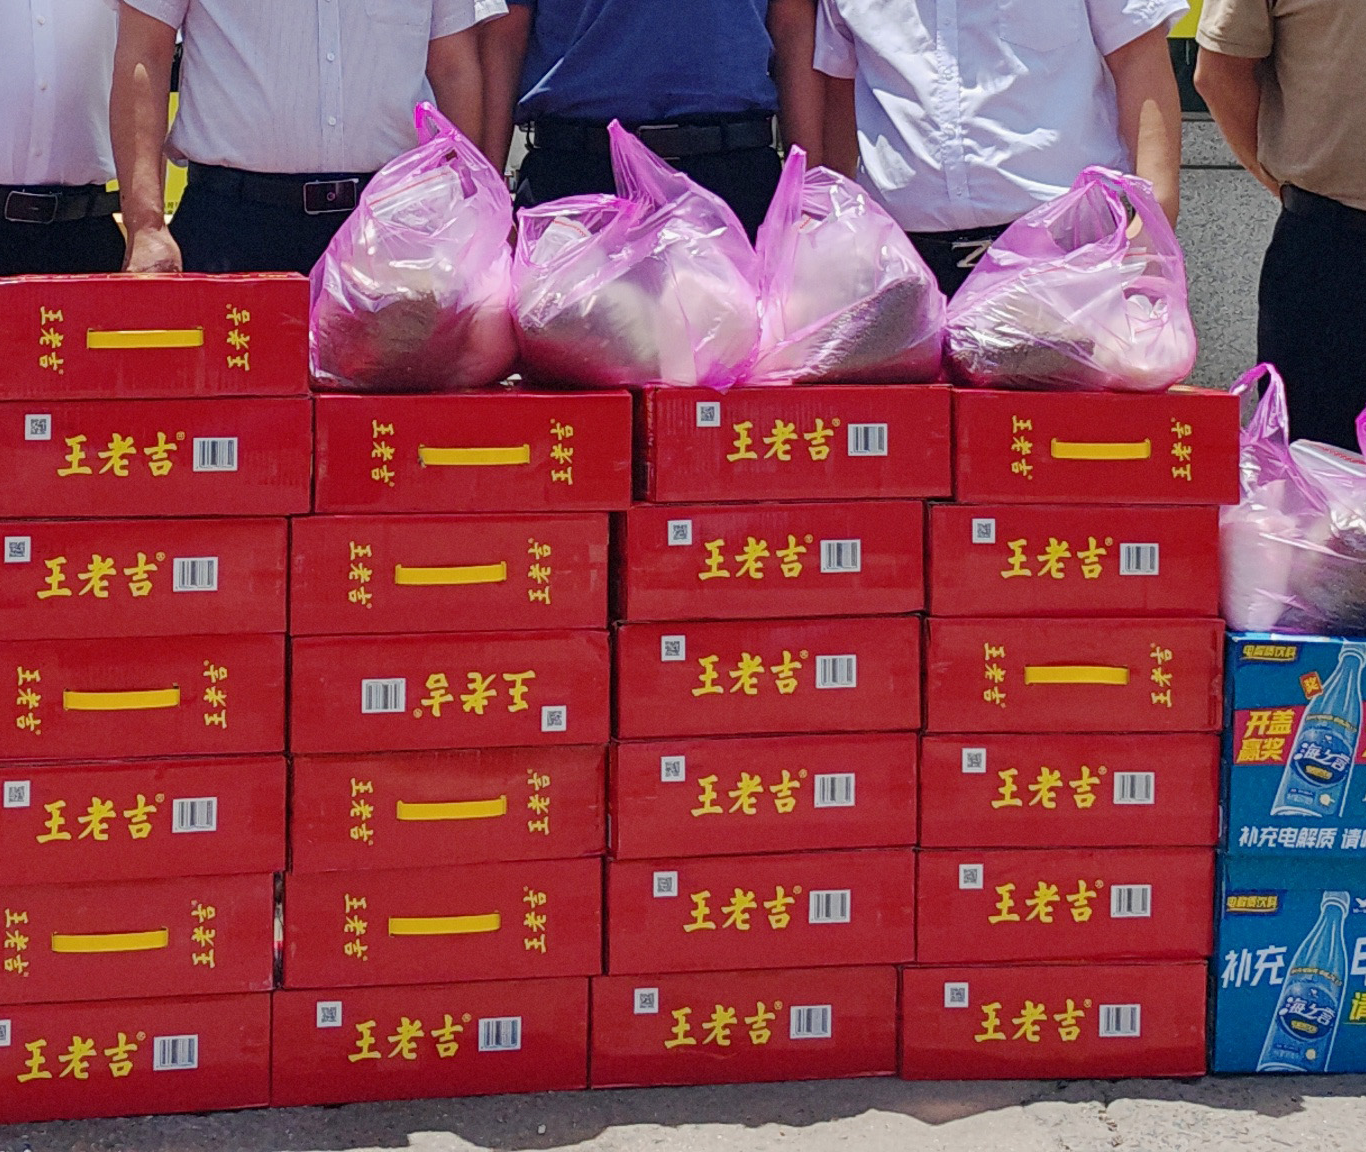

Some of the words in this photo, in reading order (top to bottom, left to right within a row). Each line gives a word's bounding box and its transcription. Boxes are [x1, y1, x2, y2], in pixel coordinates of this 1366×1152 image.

[38, 308, 64, 367] 王老吉
[225, 308, 251, 369] 王老吉
[56, 430, 178, 478] 王老吉
[370, 420, 396, 483] 王老吉
[549, 424, 575, 484] 王老吉
[726, 418, 840, 462] 王老吉
[1011, 416, 1033, 475] 王老吉
[1171, 422, 1193, 479] 王老吉
[36, 552, 165, 600] 王老吉
[347, 542, 373, 605] 王老吉
[527, 544, 552, 604] 王老吉
[699, 534, 807, 581] 王老吉
[1003, 536, 1107, 580] 王老吉
[15, 666, 41, 730] 王老吉
[203, 664, 229, 726] 王老吉
[422, 670, 537, 718] 王老吉
[691, 650, 801, 698] 王老吉
[982, 642, 1006, 704] 王老吉
[1151, 650, 1173, 706] 王老吉
[1245, 710, 1295, 737] 开盖
[1236, 739, 1284, 762] 赢奖
[349, 780, 374, 842] 王老吉
[527, 774, 551, 832] 王老吉
[694, 771, 798, 818] 王老吉
[990, 764, 1101, 810] 王老吉
[36, 794, 157, 844] 王老吉
[1239, 826, 1338, 849] 补充电解质
[523, 890, 547, 951] 王老吉
[684, 885, 792, 933] 王老吉
[987, 878, 1097, 924] 王老吉
[3, 910, 29, 973] 王老吉
[191, 906, 216, 966] 王老吉
[343, 897, 368, 958] 王老吉
[1221, 946, 1287, 988] 补充
[347, 1014, 463, 1064] 王老吉
[664, 1000, 776, 1050] 王老吉
[974, 998, 1084, 1044] 王老吉
[17, 1031, 139, 1084] 王老吉
